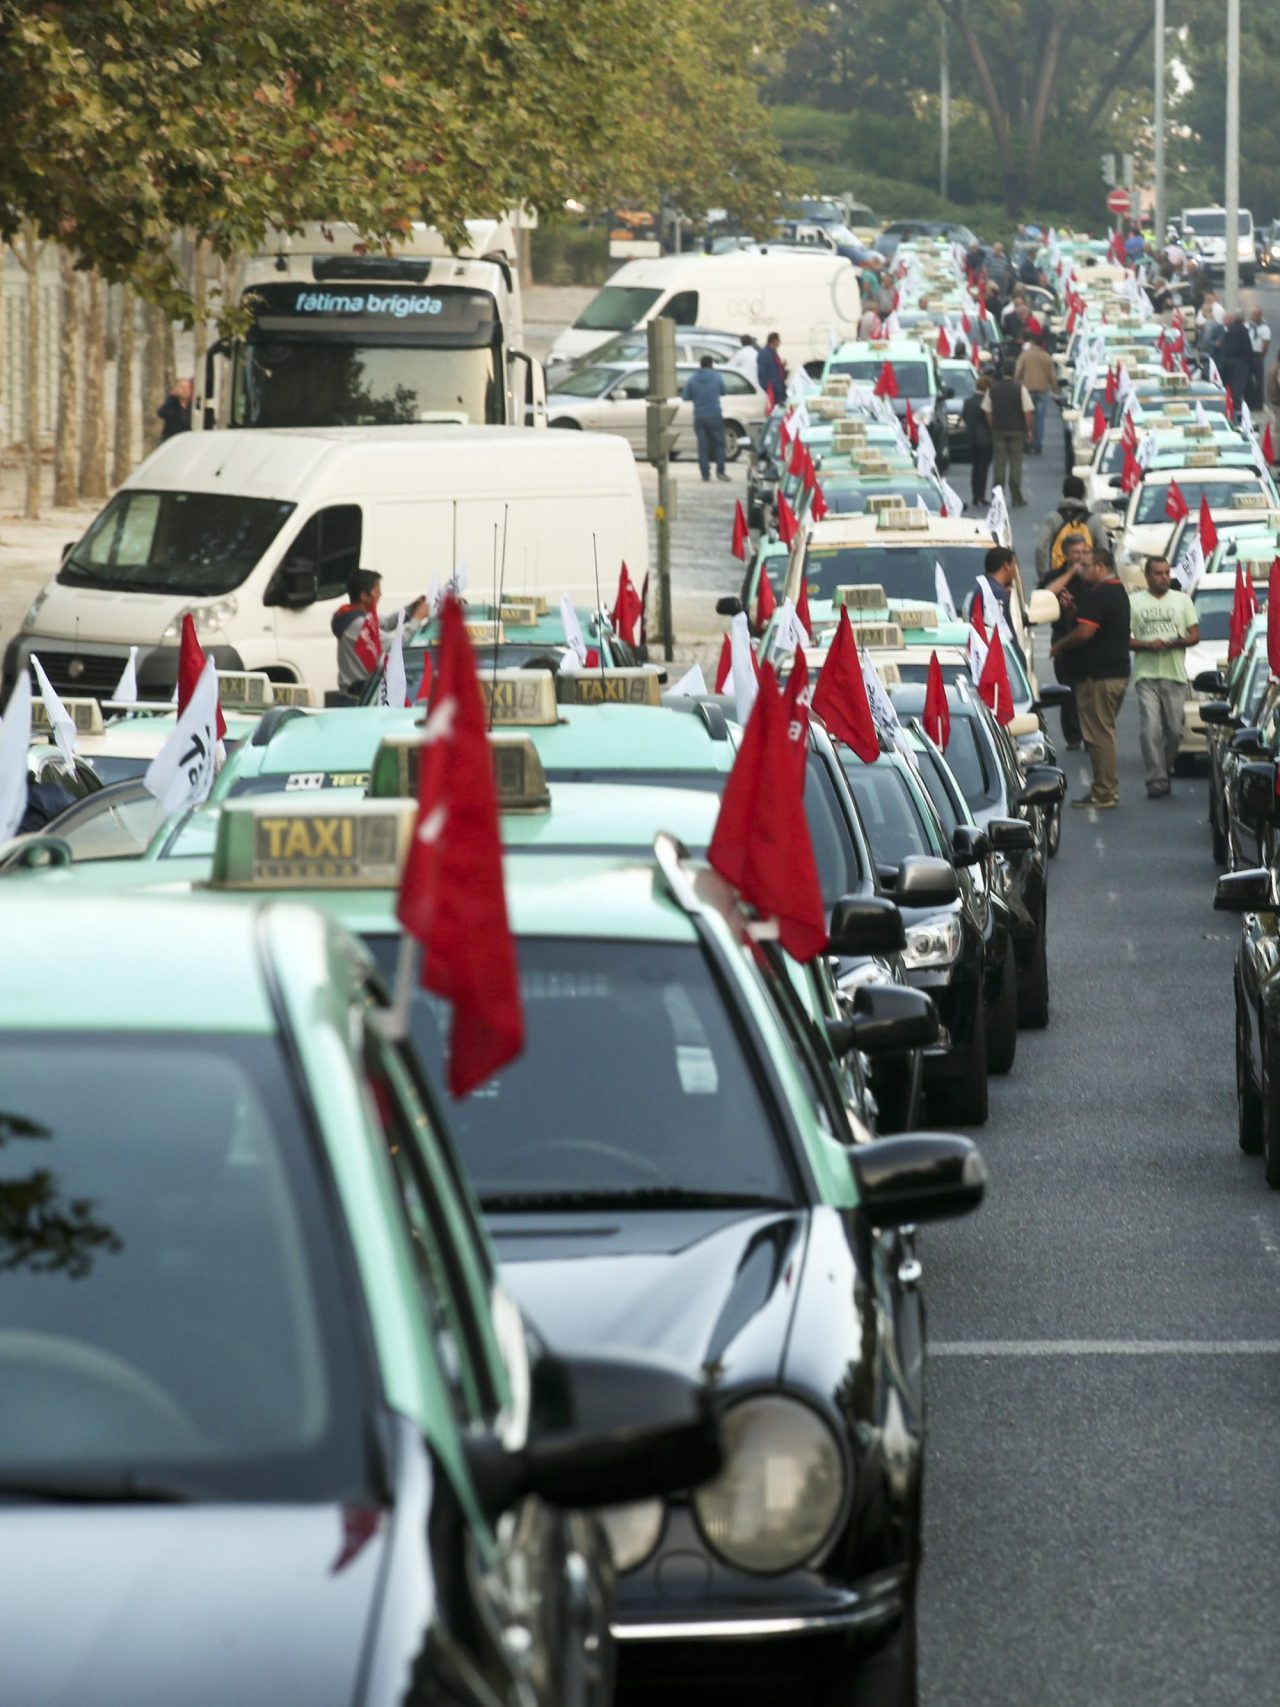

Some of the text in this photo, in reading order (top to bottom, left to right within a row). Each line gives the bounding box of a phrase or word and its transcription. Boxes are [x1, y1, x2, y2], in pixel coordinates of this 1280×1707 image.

[295, 292, 443, 318] fátima brígida
[221, 678, 246, 693] AXI
[578, 680, 625, 700] TAXI
[262, 819, 352, 859] TAXI
